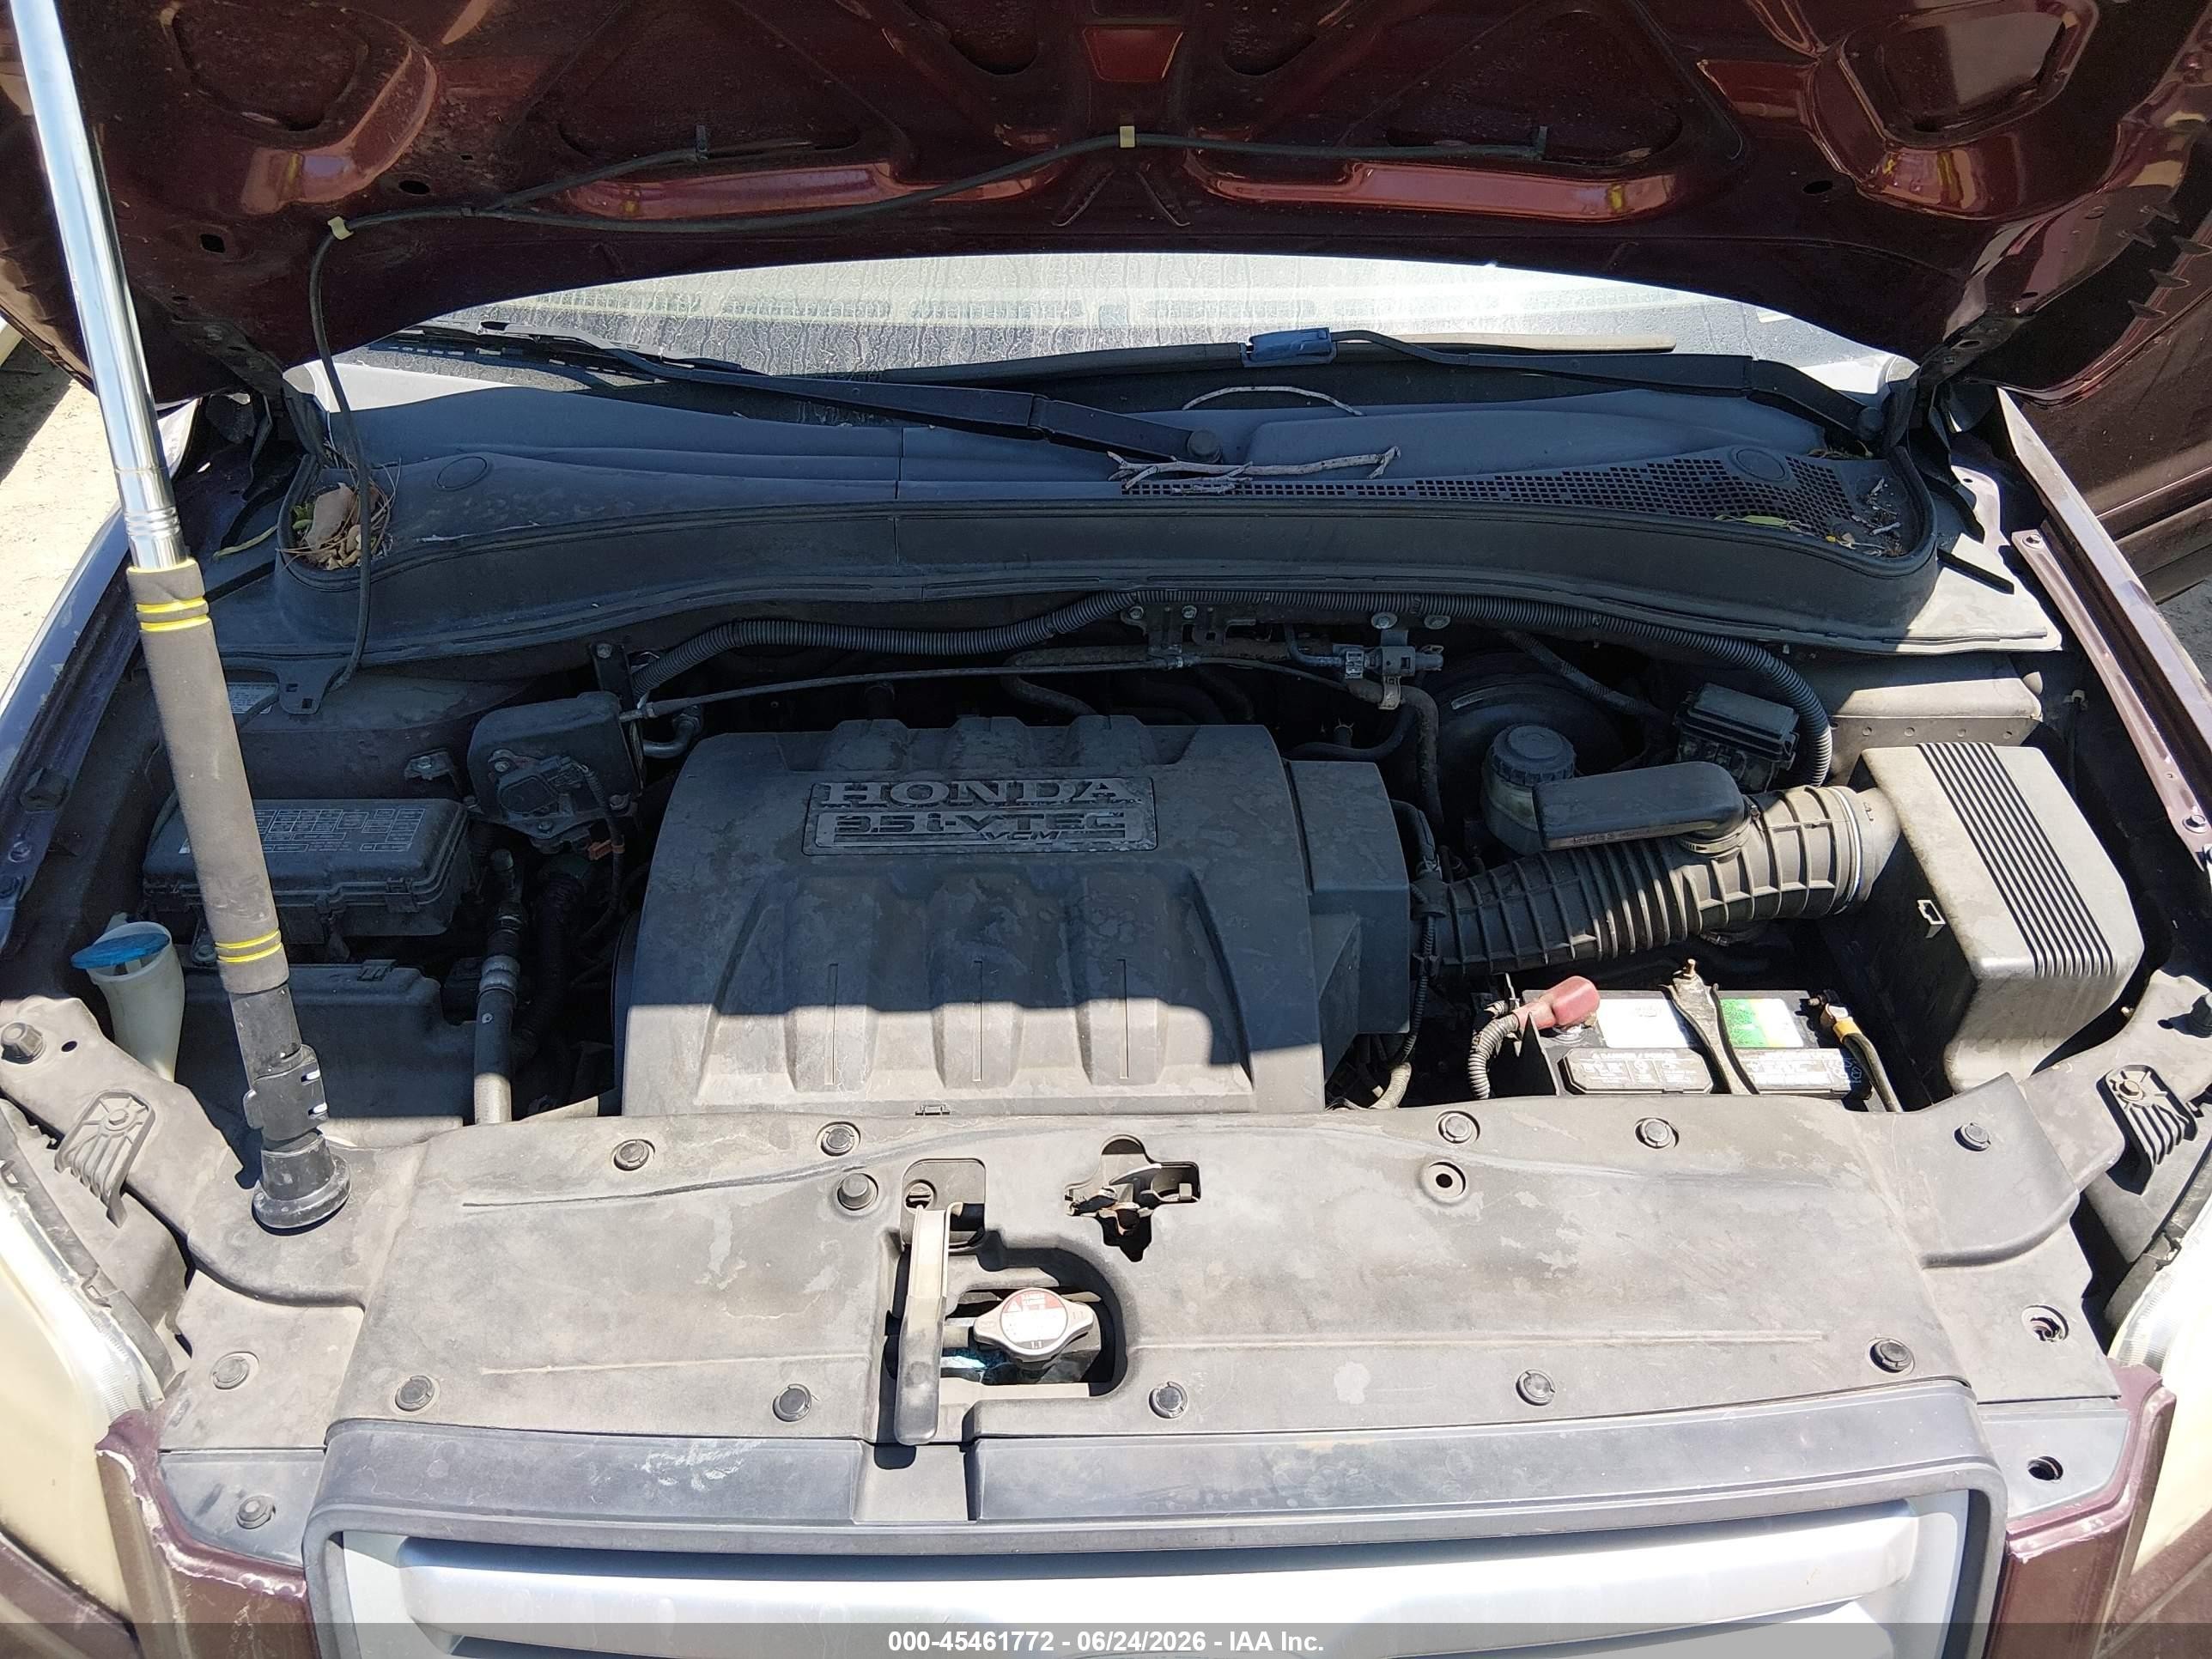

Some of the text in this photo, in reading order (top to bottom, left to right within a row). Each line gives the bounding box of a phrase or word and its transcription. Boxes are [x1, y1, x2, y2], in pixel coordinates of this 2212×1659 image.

[822, 780, 1140, 806] HONDA
[836, 811, 1125, 833] 3.5 i-VTEC
[984, 830, 1063, 842] VCM
